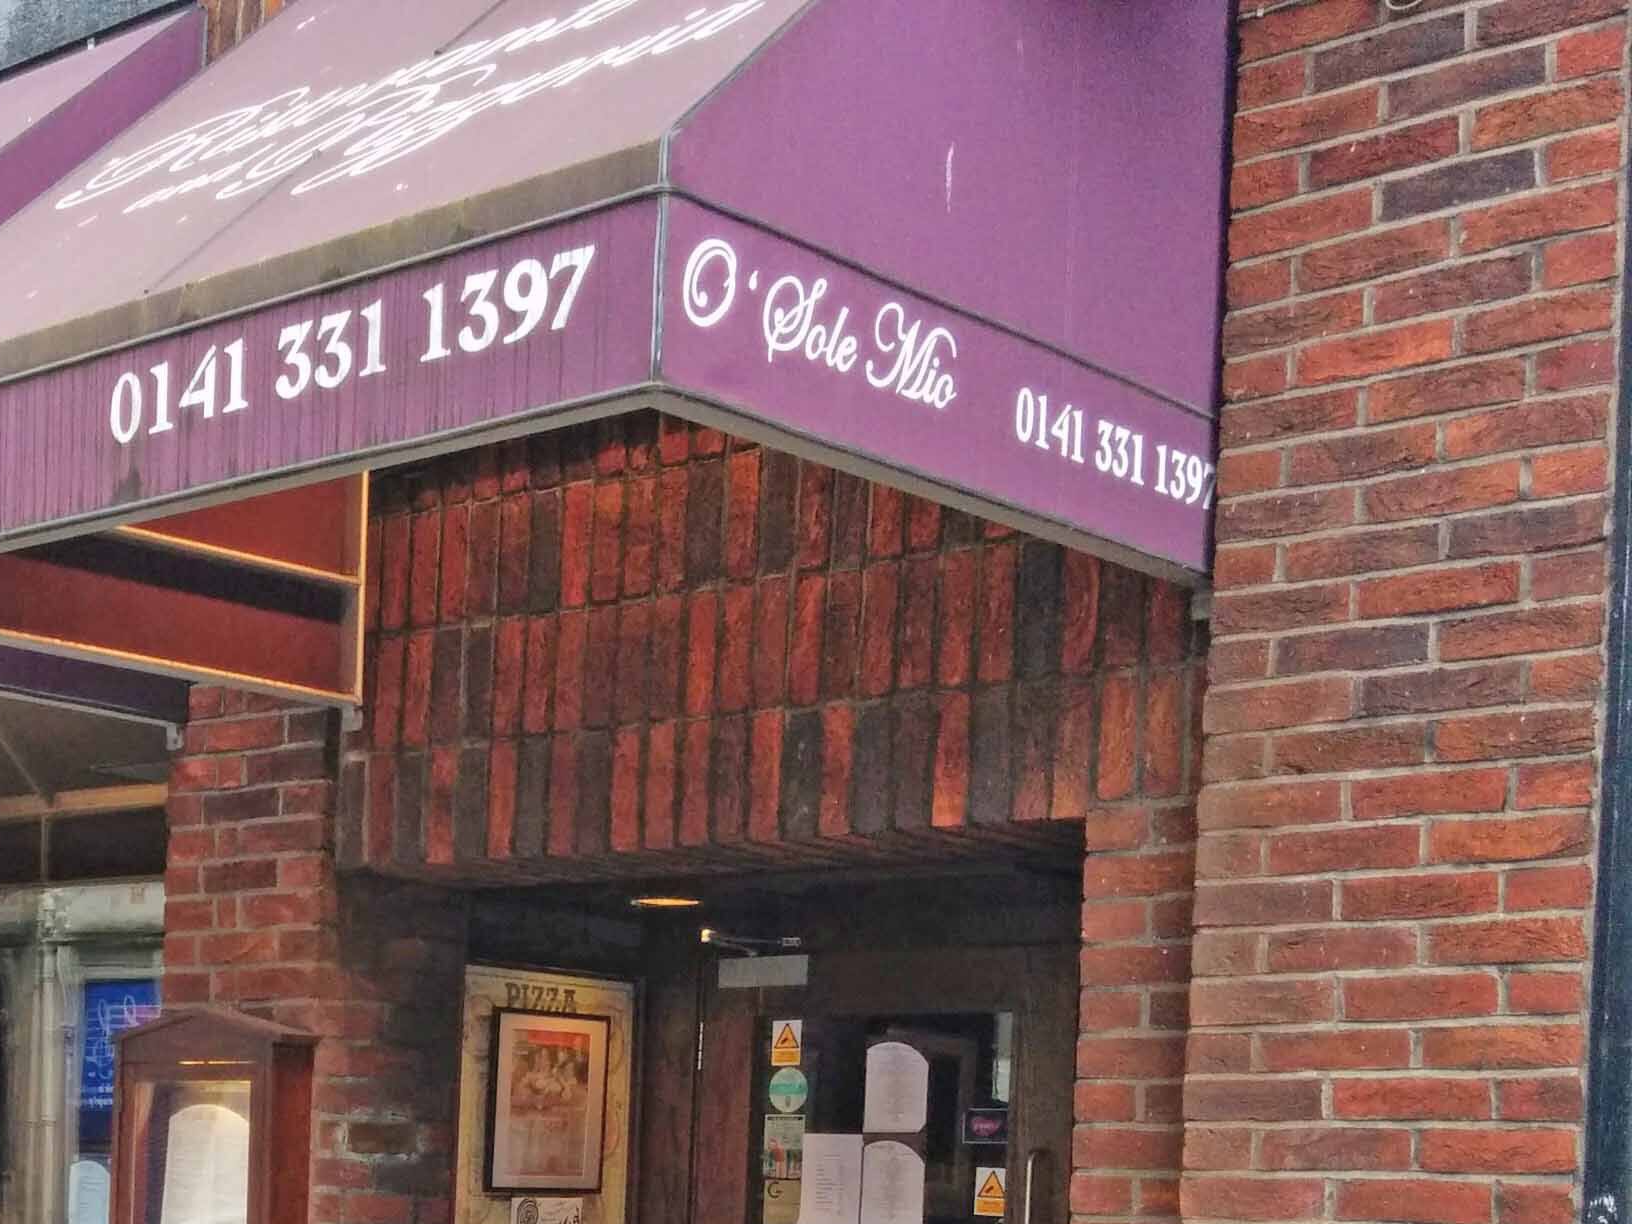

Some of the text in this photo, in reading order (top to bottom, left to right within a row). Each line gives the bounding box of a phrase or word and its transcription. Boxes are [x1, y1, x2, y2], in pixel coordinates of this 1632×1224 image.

[109, 245, 595, 445] 0141 331 1397
[866, 302, 957, 408] Mio
[1015, 387, 1084, 463] 0141
[1095, 420, 1144, 485] 331
